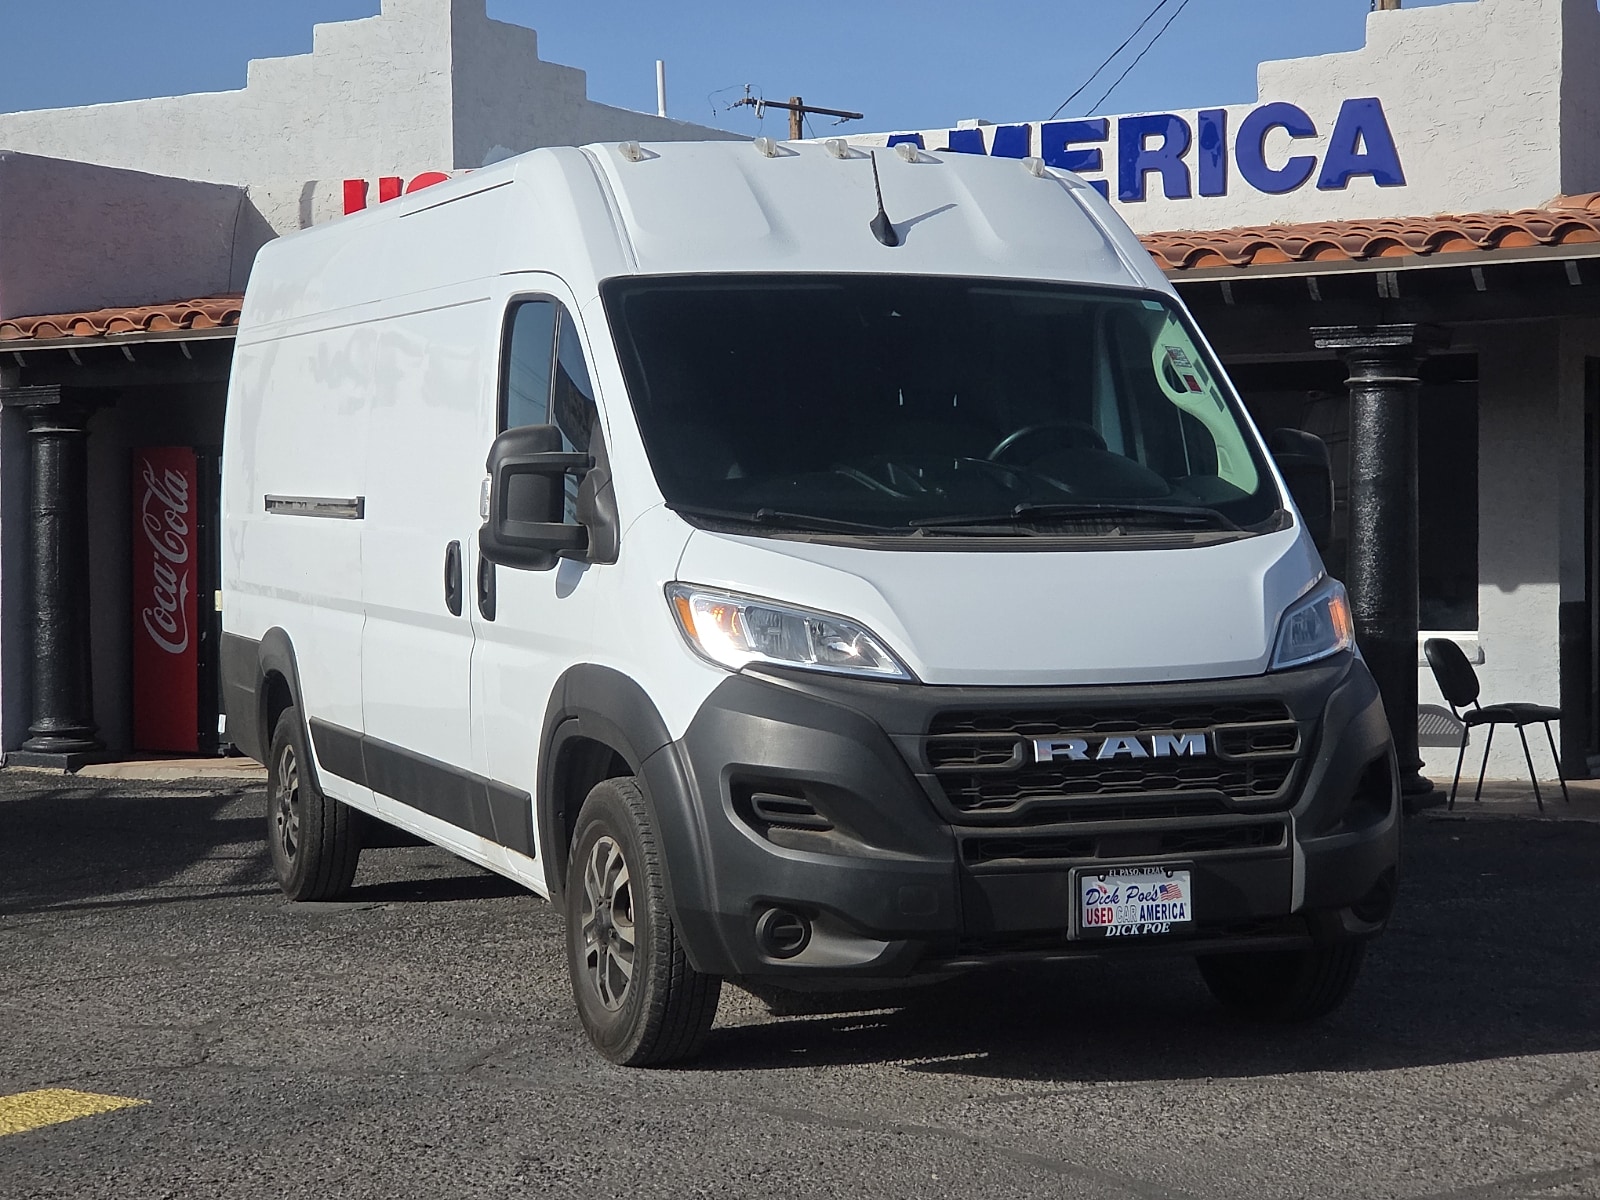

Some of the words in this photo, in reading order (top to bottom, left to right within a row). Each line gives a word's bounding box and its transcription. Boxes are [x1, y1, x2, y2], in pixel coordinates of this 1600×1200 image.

[886, 97, 1408, 204] ERICA
[1033, 734, 1207, 763] RAM
[1109, 868, 1118, 877] EL
[1143, 866, 1165, 875] TEXAS
[1085, 887, 1120, 905] Dick
[1126, 884, 1159, 903] Poe's
[1086, 907, 1113, 925] USED
[1115, 905, 1137, 924] CAR
[1139, 902, 1186, 921] AMERICA
[1105, 924, 1139, 937] DICK
[1143, 922, 1171, 934] POE
